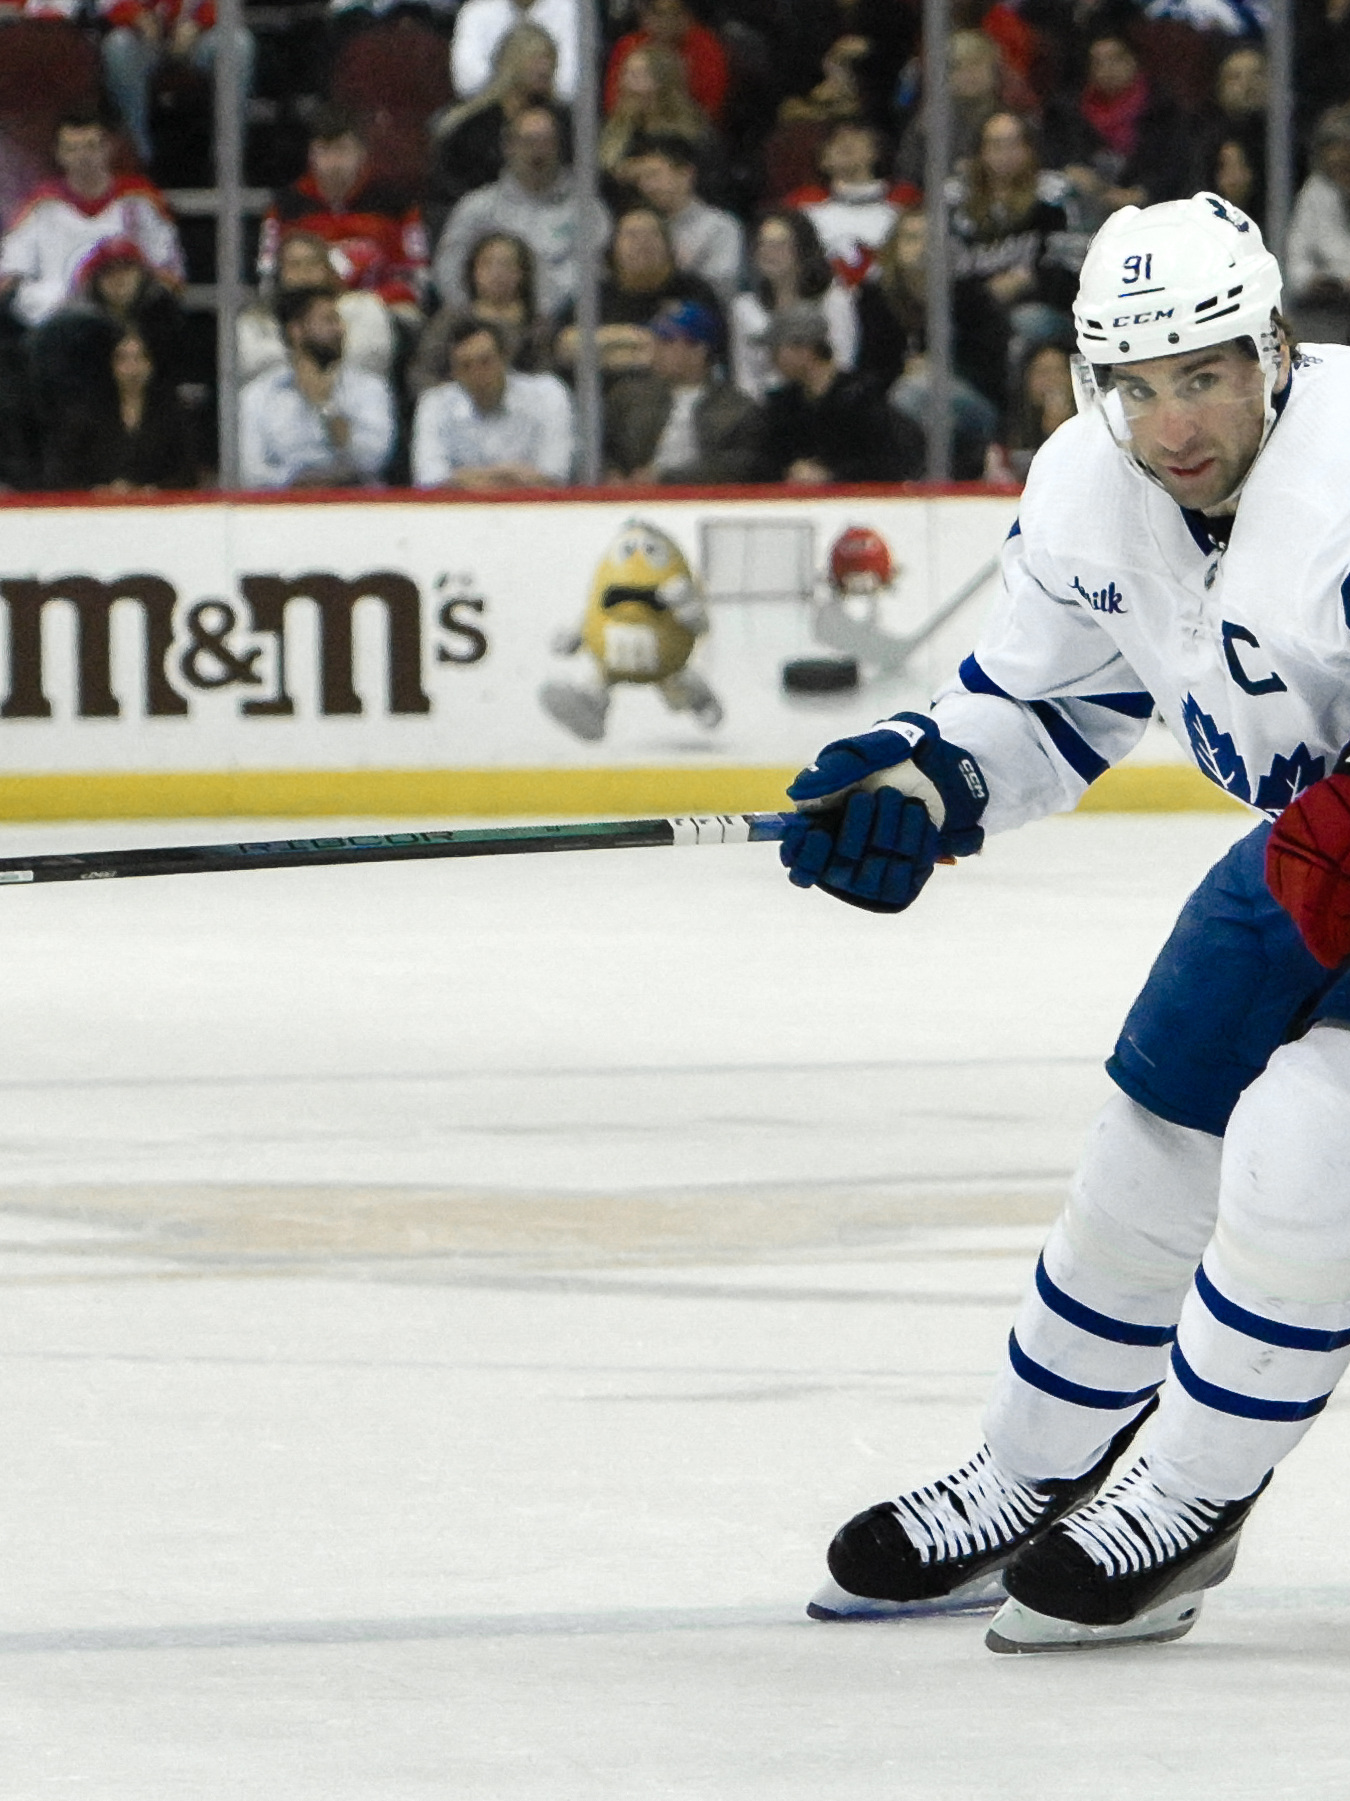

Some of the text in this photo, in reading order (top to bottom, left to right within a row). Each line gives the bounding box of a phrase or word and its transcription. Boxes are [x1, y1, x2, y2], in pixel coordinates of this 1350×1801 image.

[1122, 253, 1152, 284] 91
[1112, 308, 1175, 328] CCM
[1221, 619, 1287, 696] C
